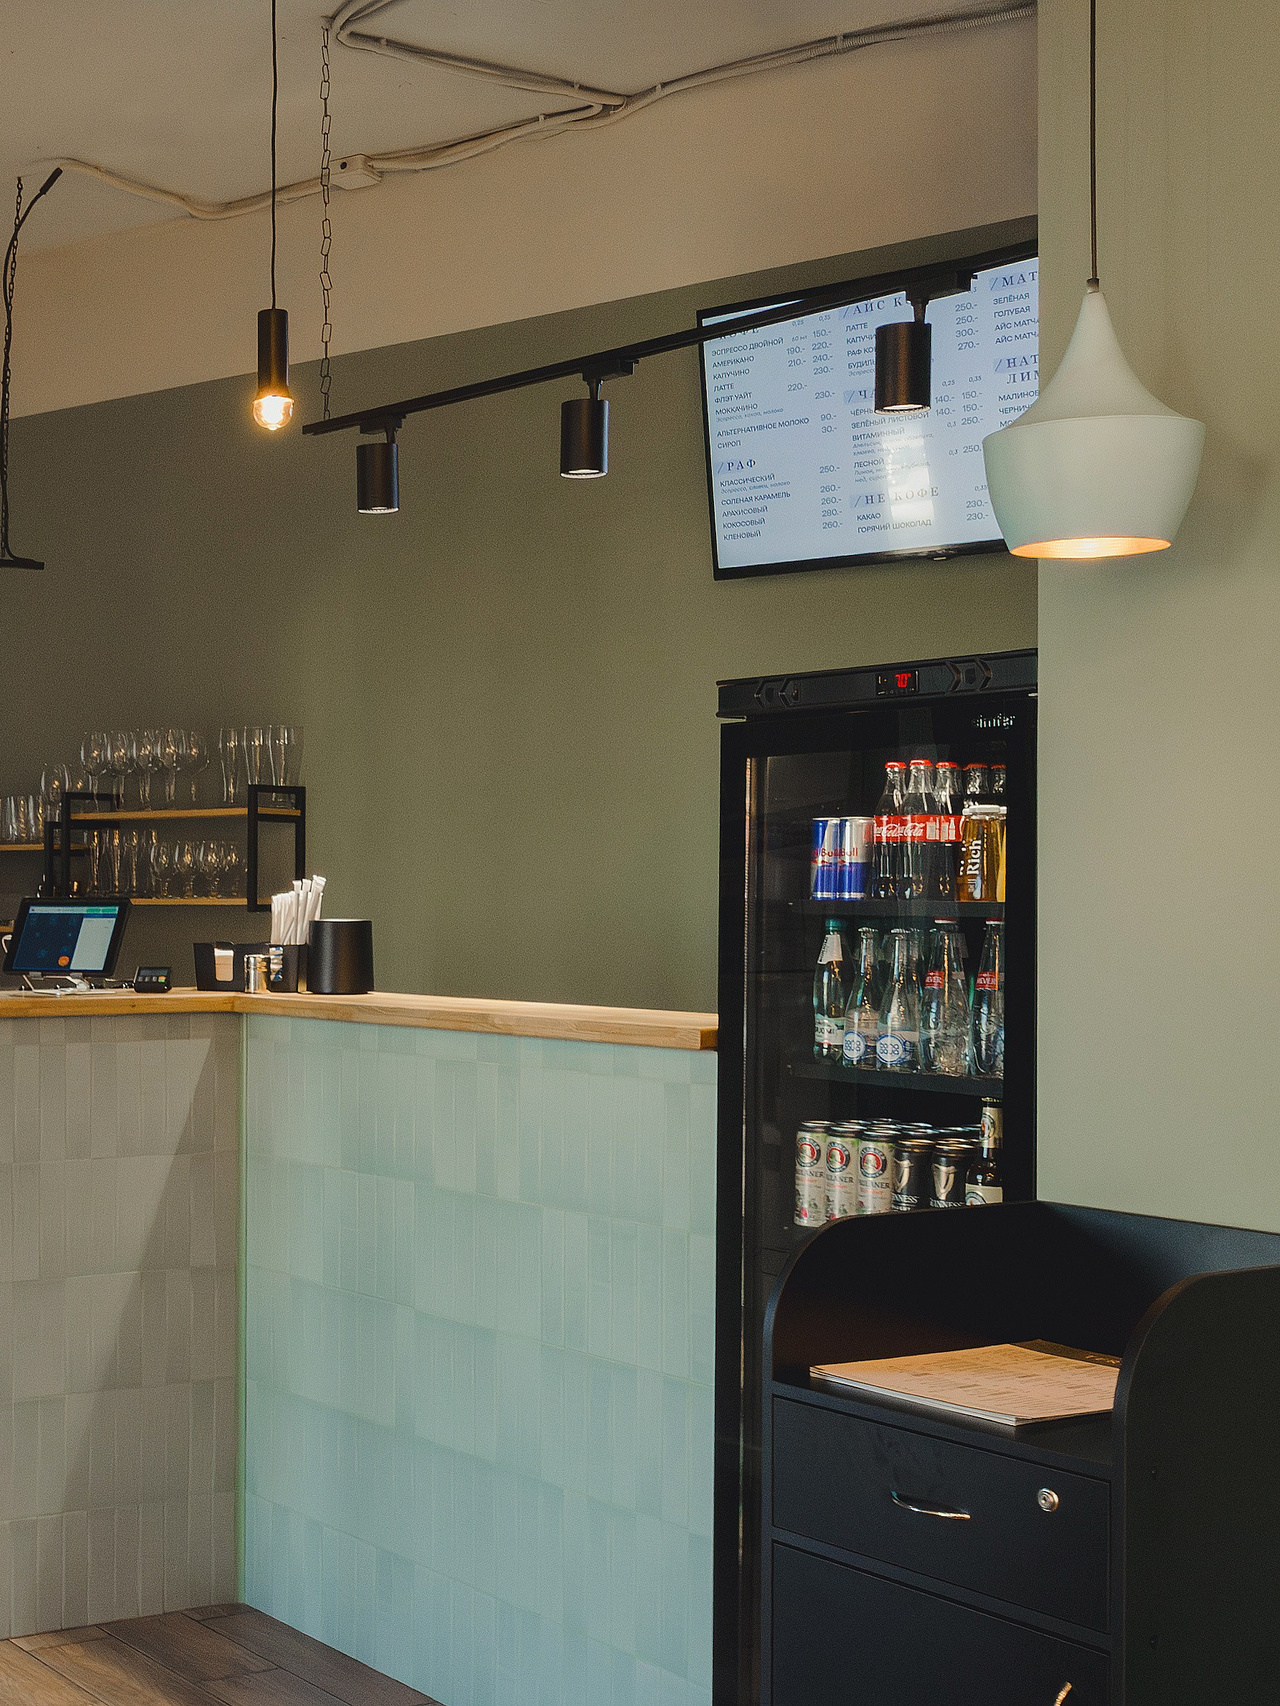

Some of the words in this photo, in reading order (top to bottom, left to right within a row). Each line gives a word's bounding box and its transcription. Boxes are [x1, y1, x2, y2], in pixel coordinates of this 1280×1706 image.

[993, 292, 1030, 305] ЗЕЛЁНАЯ
[846, 323, 868, 332] ЛАТТЕ
[955, 302, 978, 312] 250.-
[994, 306, 1031, 318] ГОЛУБАЯ
[846, 334, 876, 344] КАПУЧИ
[956, 316, 978, 325] 250.-
[995, 322, 1012, 331] АЙС
[711, 344, 748, 356] ЭСПРЕССО
[749, 337, 784, 351] ДВОЙНОЙ
[813, 329, 831, 338] 150.-
[847, 348, 862, 357] РАФ
[956, 329, 979, 338] 300.-
[958, 341, 980, 351] 270.-
[995, 335, 1013, 345] АЙС
[712, 356, 755, 369] АМЕРИКАНО
[786, 346, 805, 355] 190.-
[812, 342, 832, 351] 220.-
[713, 368, 750, 380] КАПУЧИНО
[788, 358, 806, 367] 210.-
[813, 353, 833, 363] 240.-
[714, 383, 734, 392] ЛАТТЕ
[813, 366, 834, 375] 230.-
[714, 395, 734, 404] ФЛЭТ
[735, 391, 752, 401] УАЙТ
[788, 383, 807, 391] 220.-
[715, 403, 758, 415] МОККАЧИНО
[815, 391, 835, 399] 230.-
[935, 395, 955, 404] 140.-
[962, 391, 982, 400] 150.-
[998, 390, 1039, 402] МАЛИНОВ
[851, 418, 886, 429] ЗЕЛЁНЫЙ
[888, 411, 929, 424] ЛИСТОВОЙ
[936, 407, 956, 416] 140.-
[962, 404, 983, 413] 150.-
[999, 404, 1031, 415] ЧЕРНИЧ
[717, 422, 776, 437] АЛЬТЕРНАТИВНОЕ
[778, 417, 810, 428] МОЛОКО
[820, 413, 837, 421] 90.-
[852, 428, 905, 441] ВИТАМИННЫЙ
[961, 416, 983, 426] 250.-
[717, 440, 741, 449] СИРОП
[821, 425, 837, 433] 30.-
[854, 458, 885, 469] ЛЕСНОЙ
[963, 445, 982, 454] 250.
[720, 473, 775, 487] КЛАССИЧЕСКИЙ
[819, 465, 840, 474] 250.-
[754, 491, 791, 502] КАРАМЕЛЬ
[820, 484, 841, 493] 260.-
[894, 486, 939, 501] КОФЕ
[722, 505, 768, 517] АРАХИСОВЫЙ
[821, 497, 841, 505] 260.-
[856, 512, 881, 521] КАКАО
[966, 499, 988, 508] 230.-
[723, 517, 766, 529] КОКОСОВЫЙ
[723, 529, 761, 541] КЛЕНОВЫЙ
[822, 521, 843, 529] 260.-
[857, 522, 890, 534] ГОРЯЧИЙ
[892, 518, 932, 530] ШОКОЛАД
[966, 512, 989, 521] 230.-
[966, 839, 982, 875] Rich
